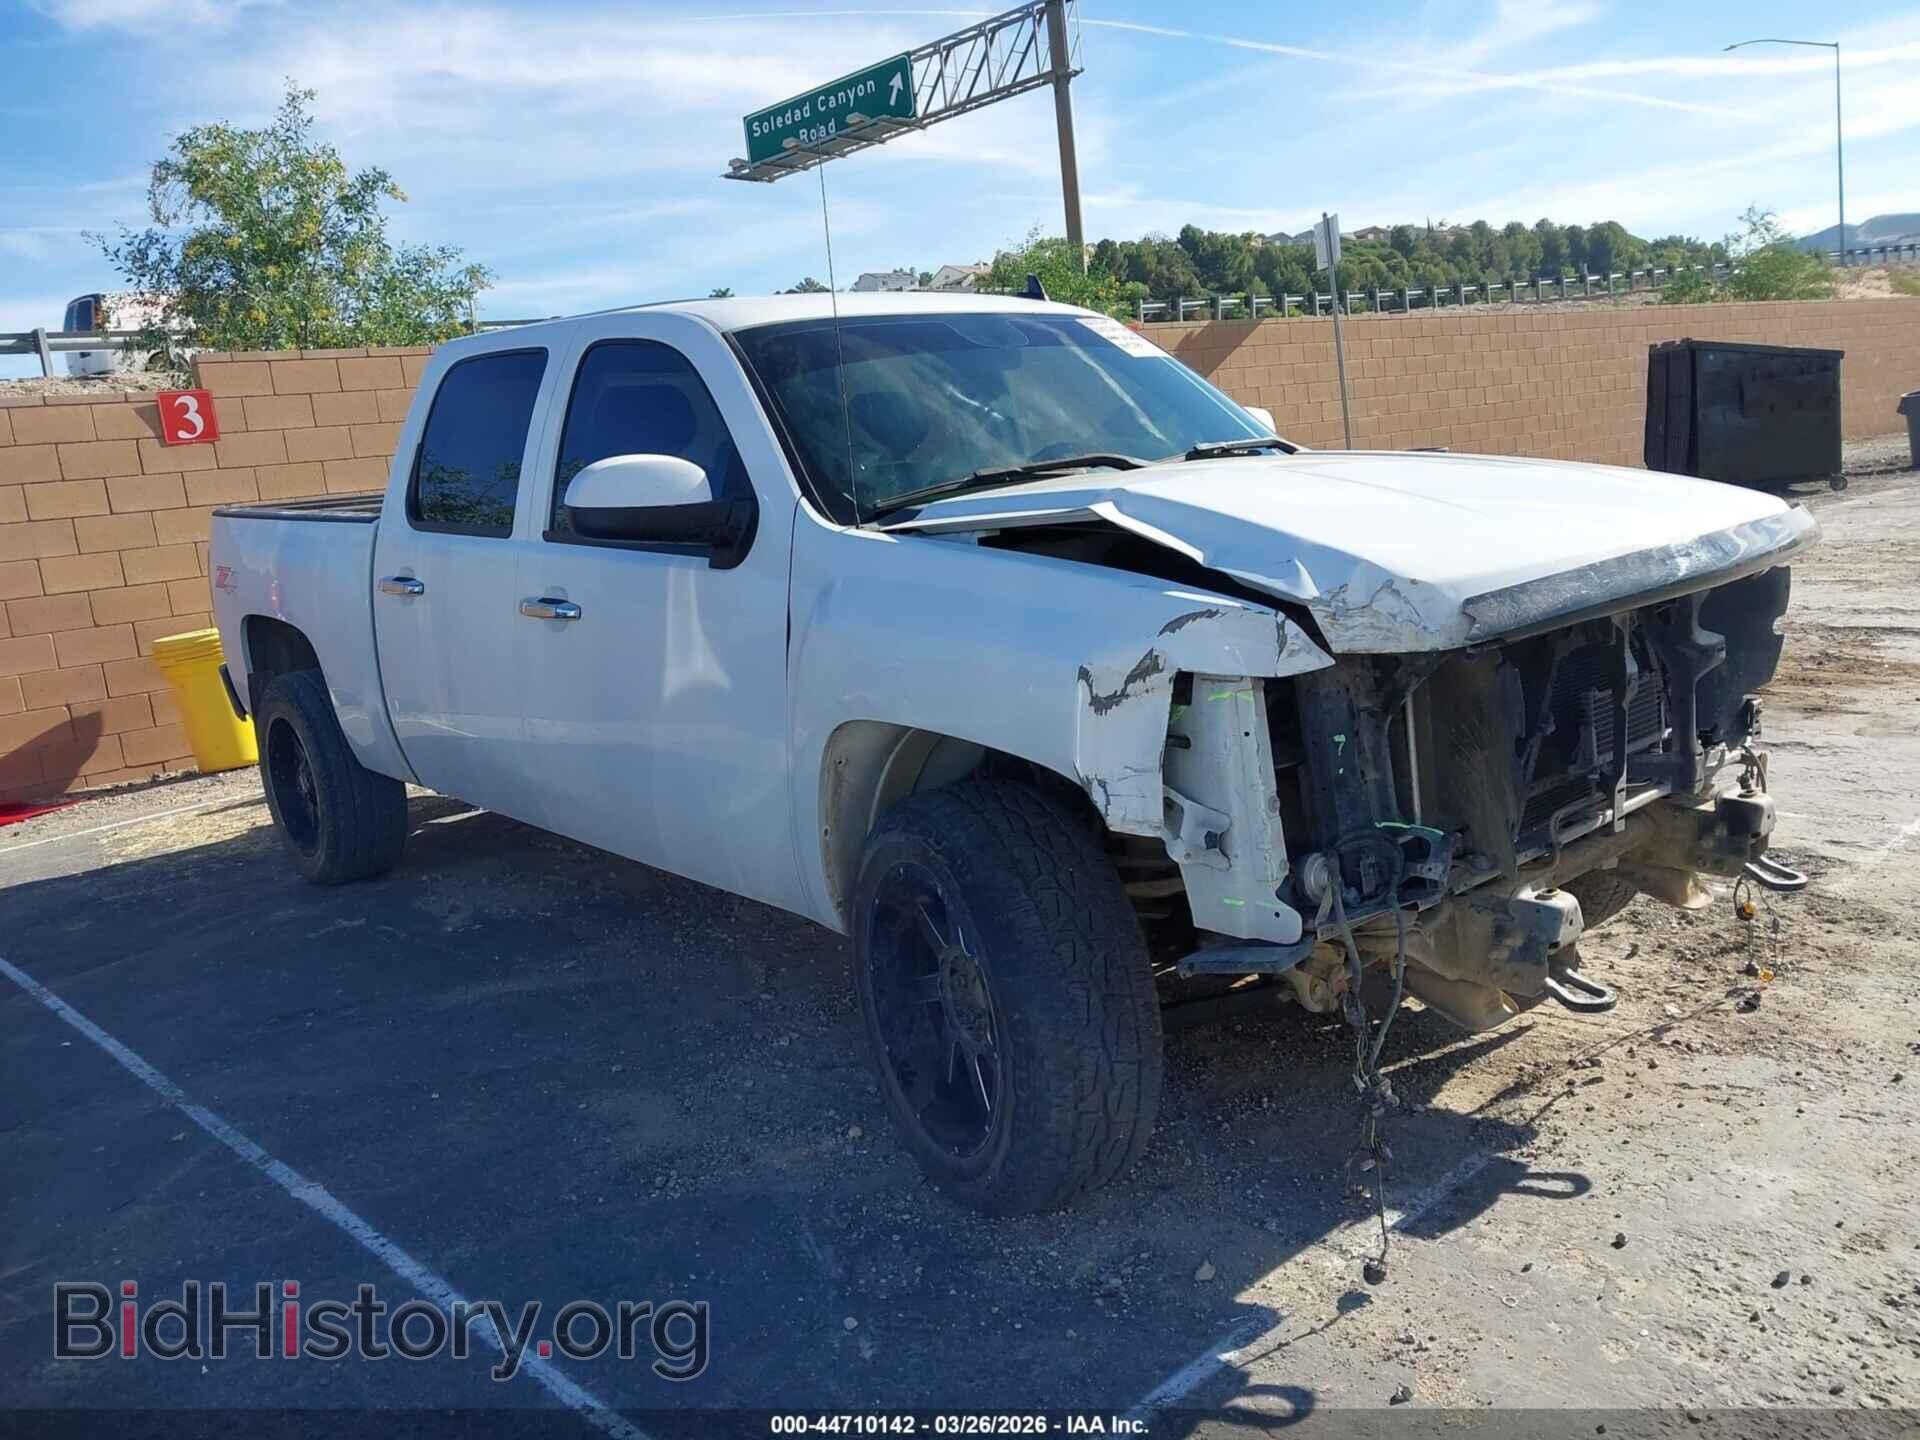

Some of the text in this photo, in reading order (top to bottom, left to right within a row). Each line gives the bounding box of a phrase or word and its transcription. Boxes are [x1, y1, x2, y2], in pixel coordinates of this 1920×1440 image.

[752, 79, 876, 137] Soledad Canyon
[799, 117, 837, 143] Road
[174, 395, 205, 439] 3
